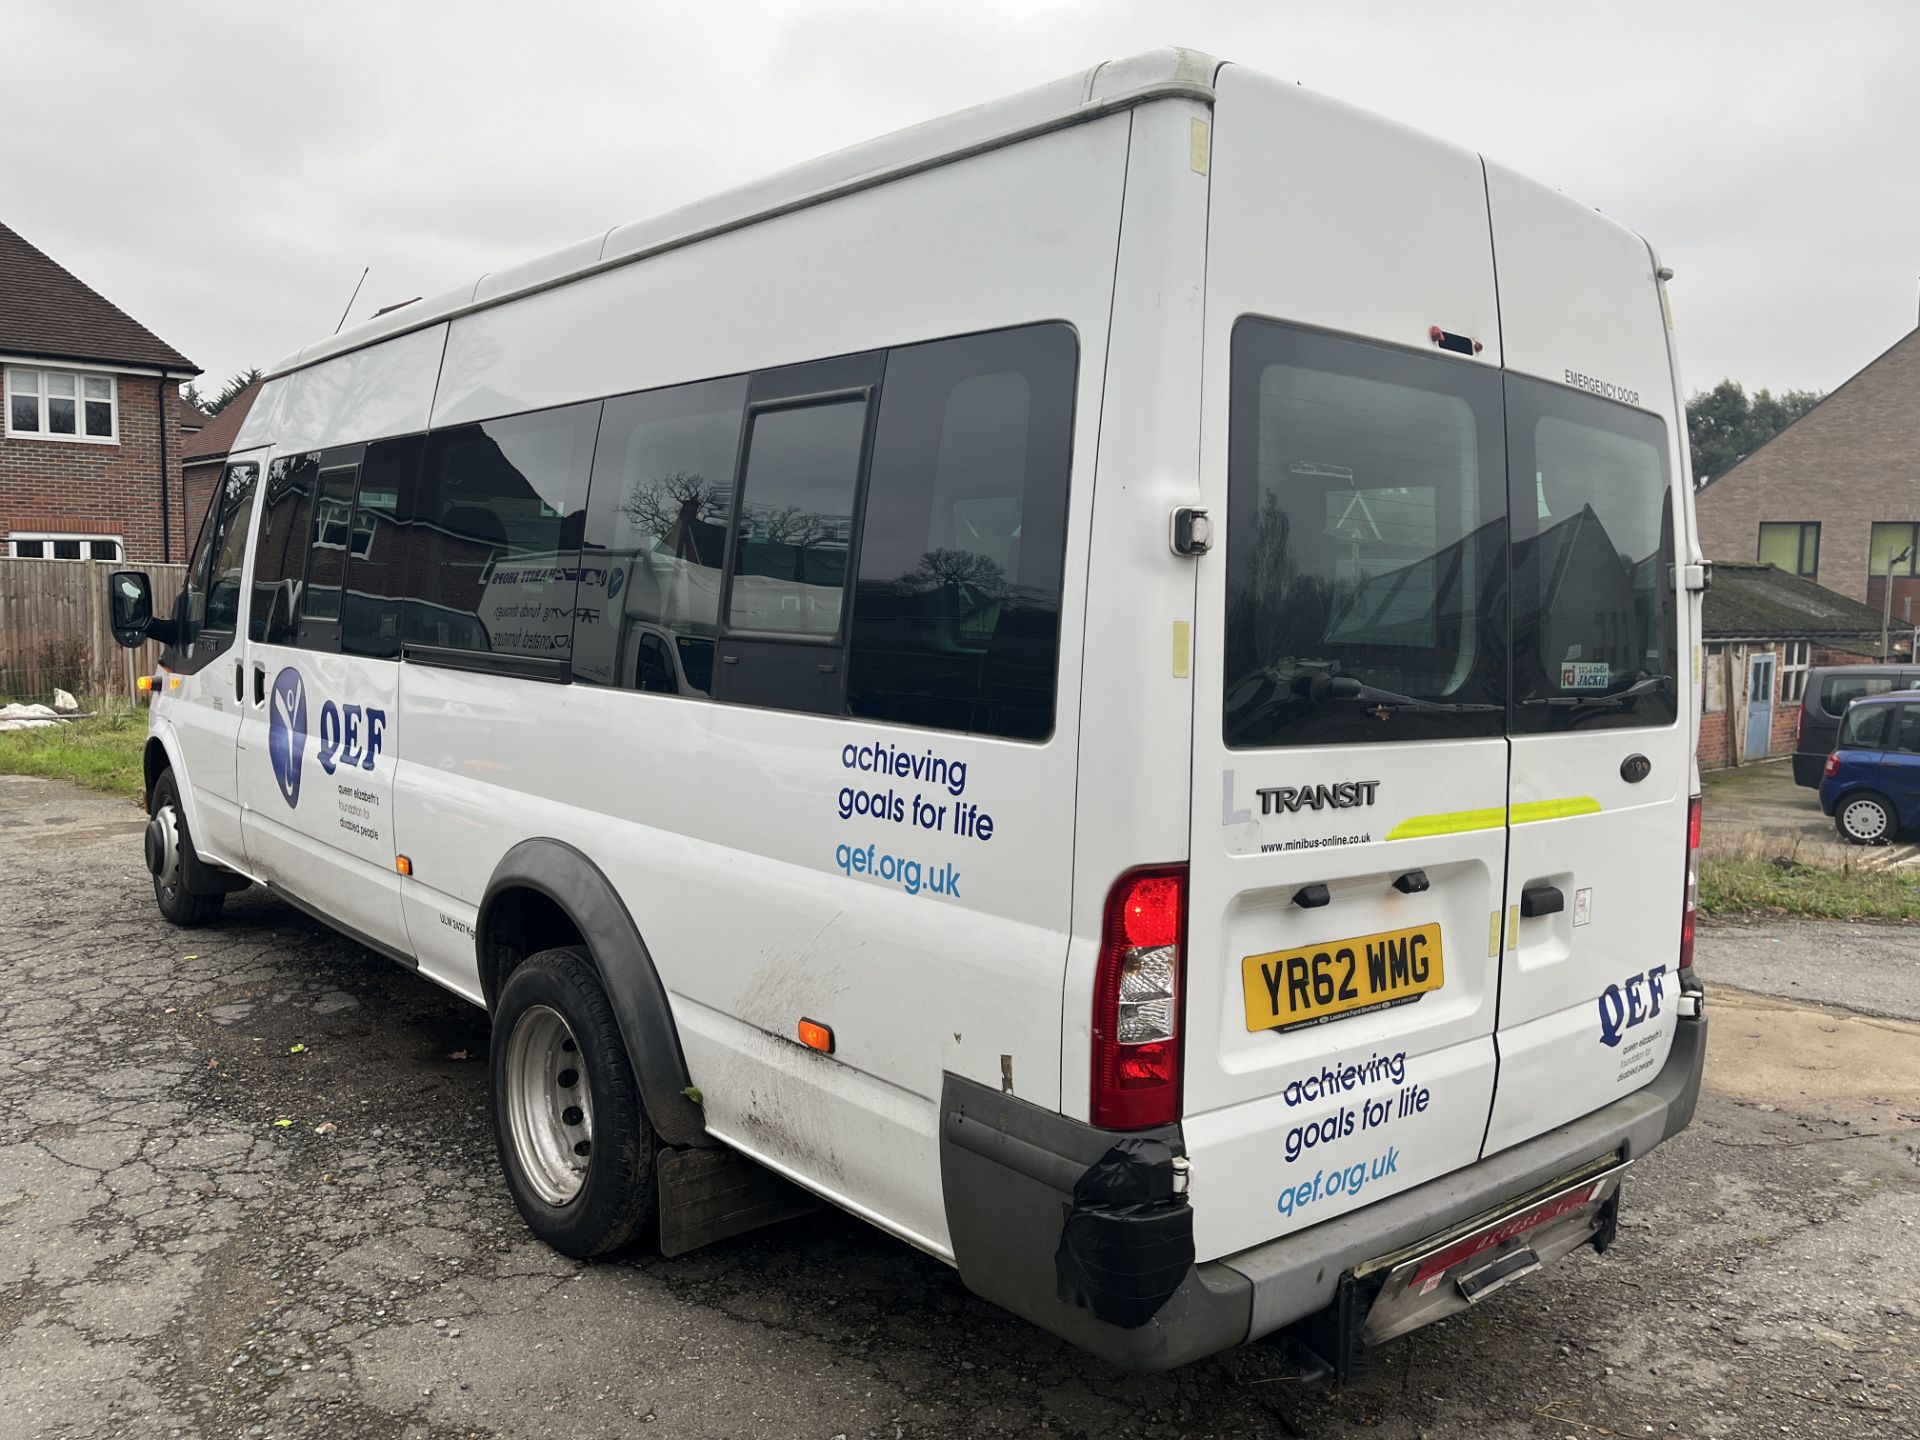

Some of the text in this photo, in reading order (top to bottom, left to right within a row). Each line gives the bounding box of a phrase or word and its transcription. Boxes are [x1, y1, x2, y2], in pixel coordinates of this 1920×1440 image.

[1565, 369, 1640, 406] EMERGENCY DOOR
[317, 700, 386, 775] QEF
[338, 784, 353, 797] queen
[842, 742, 967, 796] achieving
[838, 787, 994, 841] goals for life
[1256, 780, 1380, 814] TRANSIT
[836, 843, 961, 898] qef.org.uk
[1261, 833, 1371, 853] www.minibus-online.co.uk
[1261, 934, 1429, 1016] YR62 WMG
[1599, 964, 1666, 1047] QEF
[1283, 1052, 1406, 1107] achieving
[1285, 1084, 1430, 1163] goals for life
[1277, 1146, 1400, 1217] qef.org.uk
